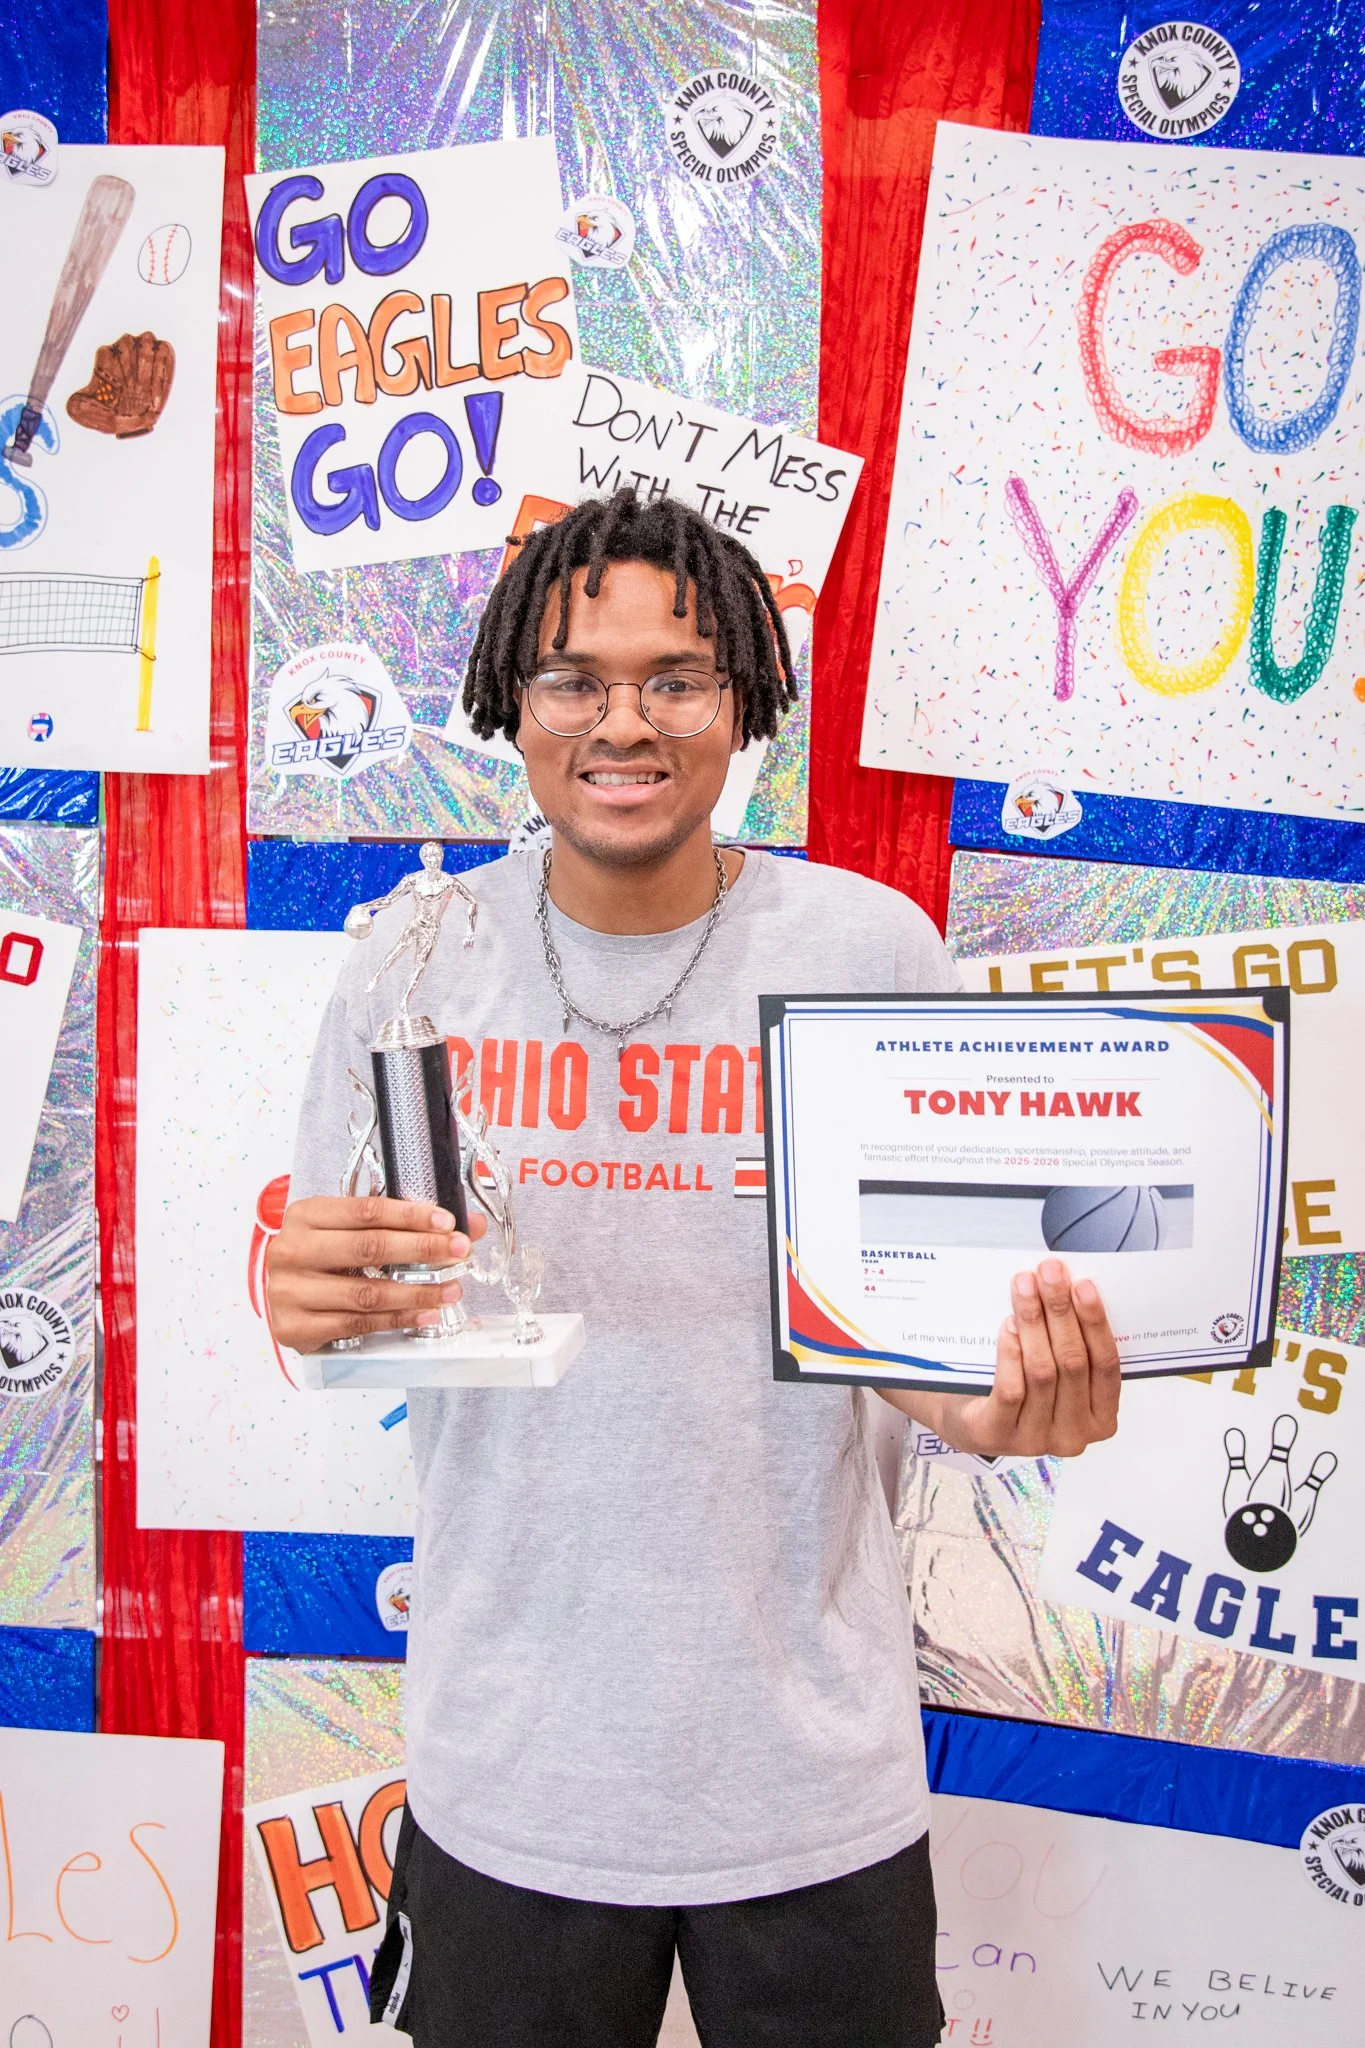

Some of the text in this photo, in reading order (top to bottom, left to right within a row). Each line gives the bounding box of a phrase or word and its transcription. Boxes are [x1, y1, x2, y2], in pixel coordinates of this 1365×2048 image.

[1133, 24, 1236, 70] KNOX COUNTY
[674, 72, 776, 112] KNOX COUNTY
[1121, 74, 1230, 135] SPECIAL OLYMPICS
[670, 131, 777, 183] SPECIAL OLYMPICS
[254, 173, 428, 285] GO
[555, 227, 629, 266] EAGLES
[269, 277, 573, 415] EAGLES
[1075, 217, 1362, 458] GO
[573, 373, 848, 502] DON'T MESS
[291, 391, 504, 535] GO!
[696, 482, 770, 535] THE
[1004, 471, 1361, 705] YOU
[288, 650, 367, 677] KNOX COUNTY
[271, 725, 407, 766] EAGLES
[1004, 810, 1081, 831] EAGLES
[1232, 939, 1338, 995] GO
[876, 1041, 1170, 1053] ATHLETE ACHIEVEMENT AWARD
[986, 1074, 1055, 1084] Presented to
[904, 1089, 1143, 1117] TONY HAWK
[864, 1152, 902, 1162] fantastic
[904, 1153, 929, 1162] effort
[931, 1154, 984, 1165] throughout
[986, 1156, 1002, 1165] the
[1062, 1158, 1097, 1168] Special
[1099, 1158, 1145, 1168] Olympics
[871, 1143, 923, 1153] recognition
[937, 1146, 957, 1154] your
[1090, 1146, 1129, 1157] positive
[1172, 1145, 1191, 1155] and
[519, 1158, 713, 1191] FOOTBALL
[861, 1250, 937, 1260] BASKETBALL
[27, 1296, 71, 1345] COUNTY
[902, 1332, 917, 1341] Let
[920, 1334, 935, 1342] me
[960, 1335, 976, 1345] But
[978, 1336, 985, 1345] if
[1132, 1333, 1141, 1341] in
[1143, 1331, 1159, 1340] the
[1076, 1519, 1359, 1661] EAGLE
[1310, 1808, 1355, 1840] KNOX
[1305, 1856, 1350, 1904] SPECIAL
[1097, 1961, 1338, 2000] WE BELIVE
[1131, 2002, 1241, 2021] IN YOU
